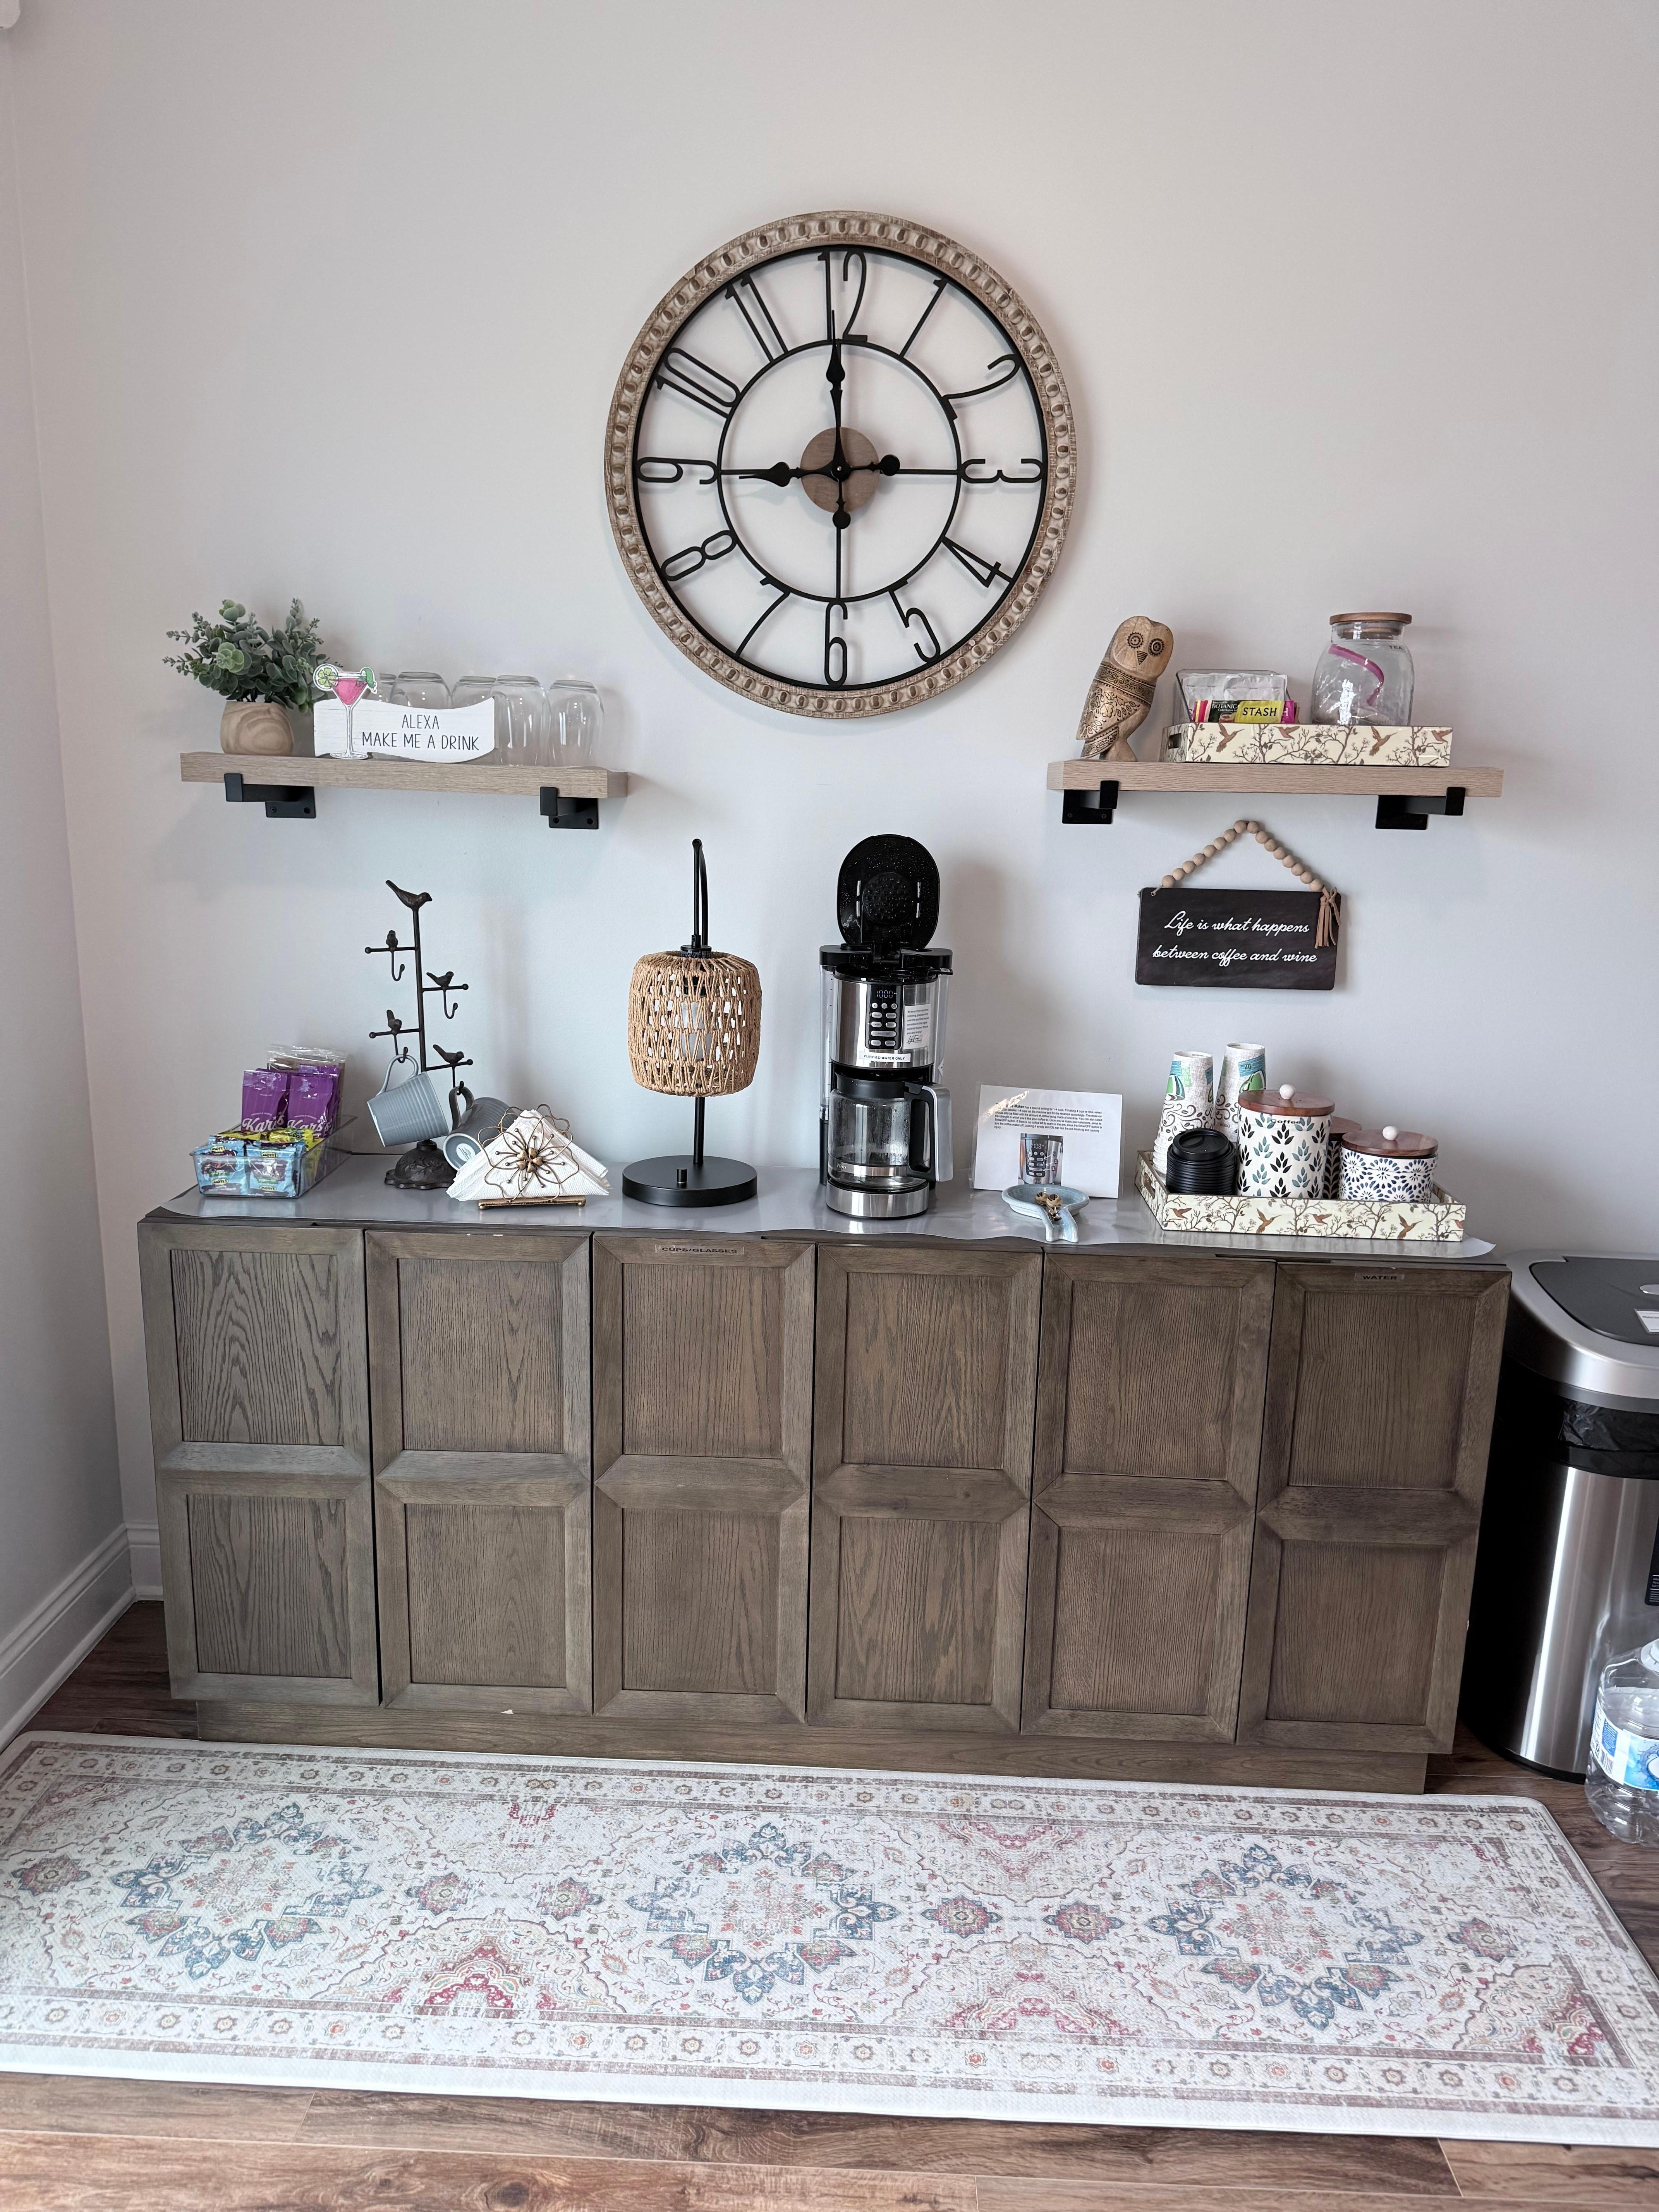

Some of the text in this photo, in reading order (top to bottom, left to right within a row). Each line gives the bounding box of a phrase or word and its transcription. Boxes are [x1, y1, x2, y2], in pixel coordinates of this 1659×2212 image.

[725, 274, 788, 362] 11
[818, 250, 867, 341] 12
[900, 278, 948, 357] 1
[656, 347, 740, 418] 10
[940, 354, 1021, 422] 2
[635, 457, 719, 484] 9
[959, 458, 1045, 484] 3
[661, 529, 736, 582] 8
[942, 536, 1013, 587] 4
[735, 577, 789, 658] 7
[824, 599, 847, 686] 6
[889, 579, 940, 663] 5
[402, 714, 439, 730] ALEXA
[1243, 708, 1277, 716] STASH
[362, 732, 479, 750] MAKE ME A DRINK
[1164, 911, 1309, 936] Life is what happens
[1152, 945, 1317, 967] between coffee and wine
